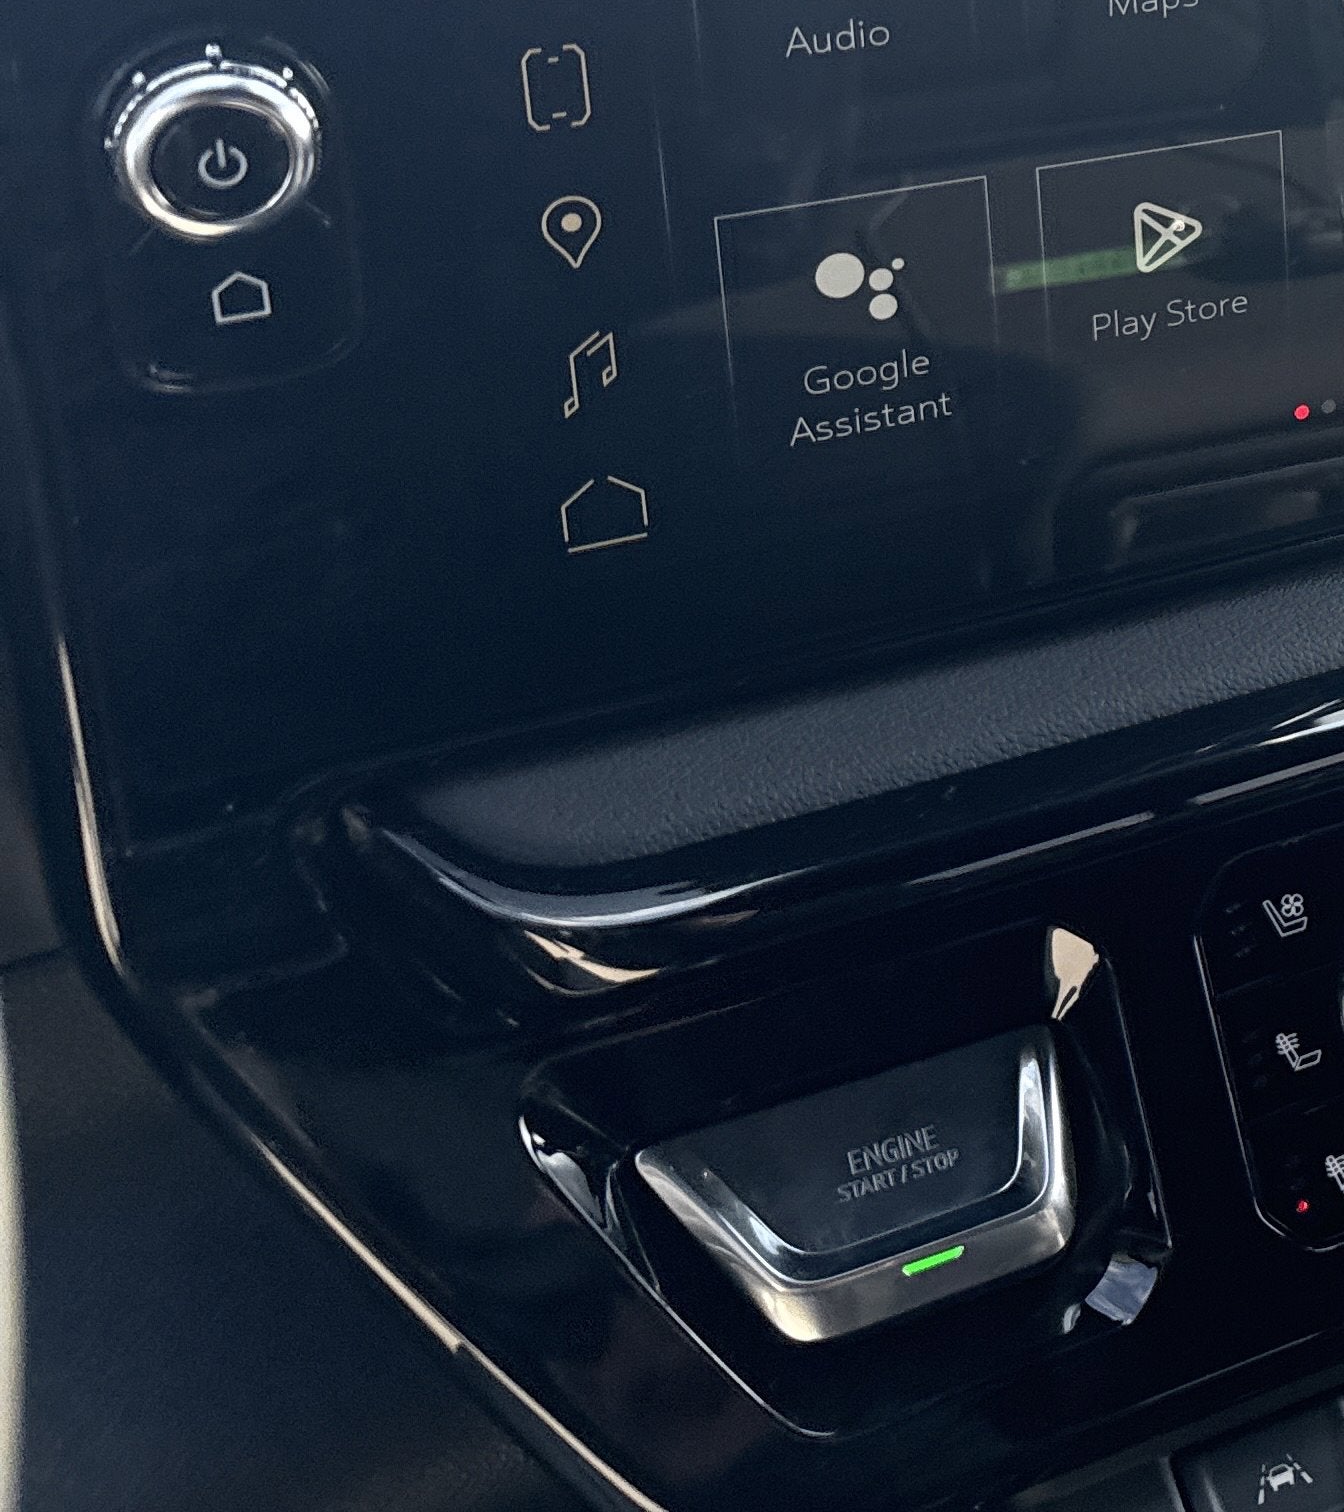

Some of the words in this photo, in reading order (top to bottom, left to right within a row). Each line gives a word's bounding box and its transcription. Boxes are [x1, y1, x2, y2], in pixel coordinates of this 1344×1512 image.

[785, 18, 891, 58] Audio
[1091, 308, 1157, 343] Play
[1166, 293, 1249, 328] Store
[803, 348, 930, 391] Google
[789, 391, 954, 448] Assistant
[846, 1123, 941, 1176] ENGINE
